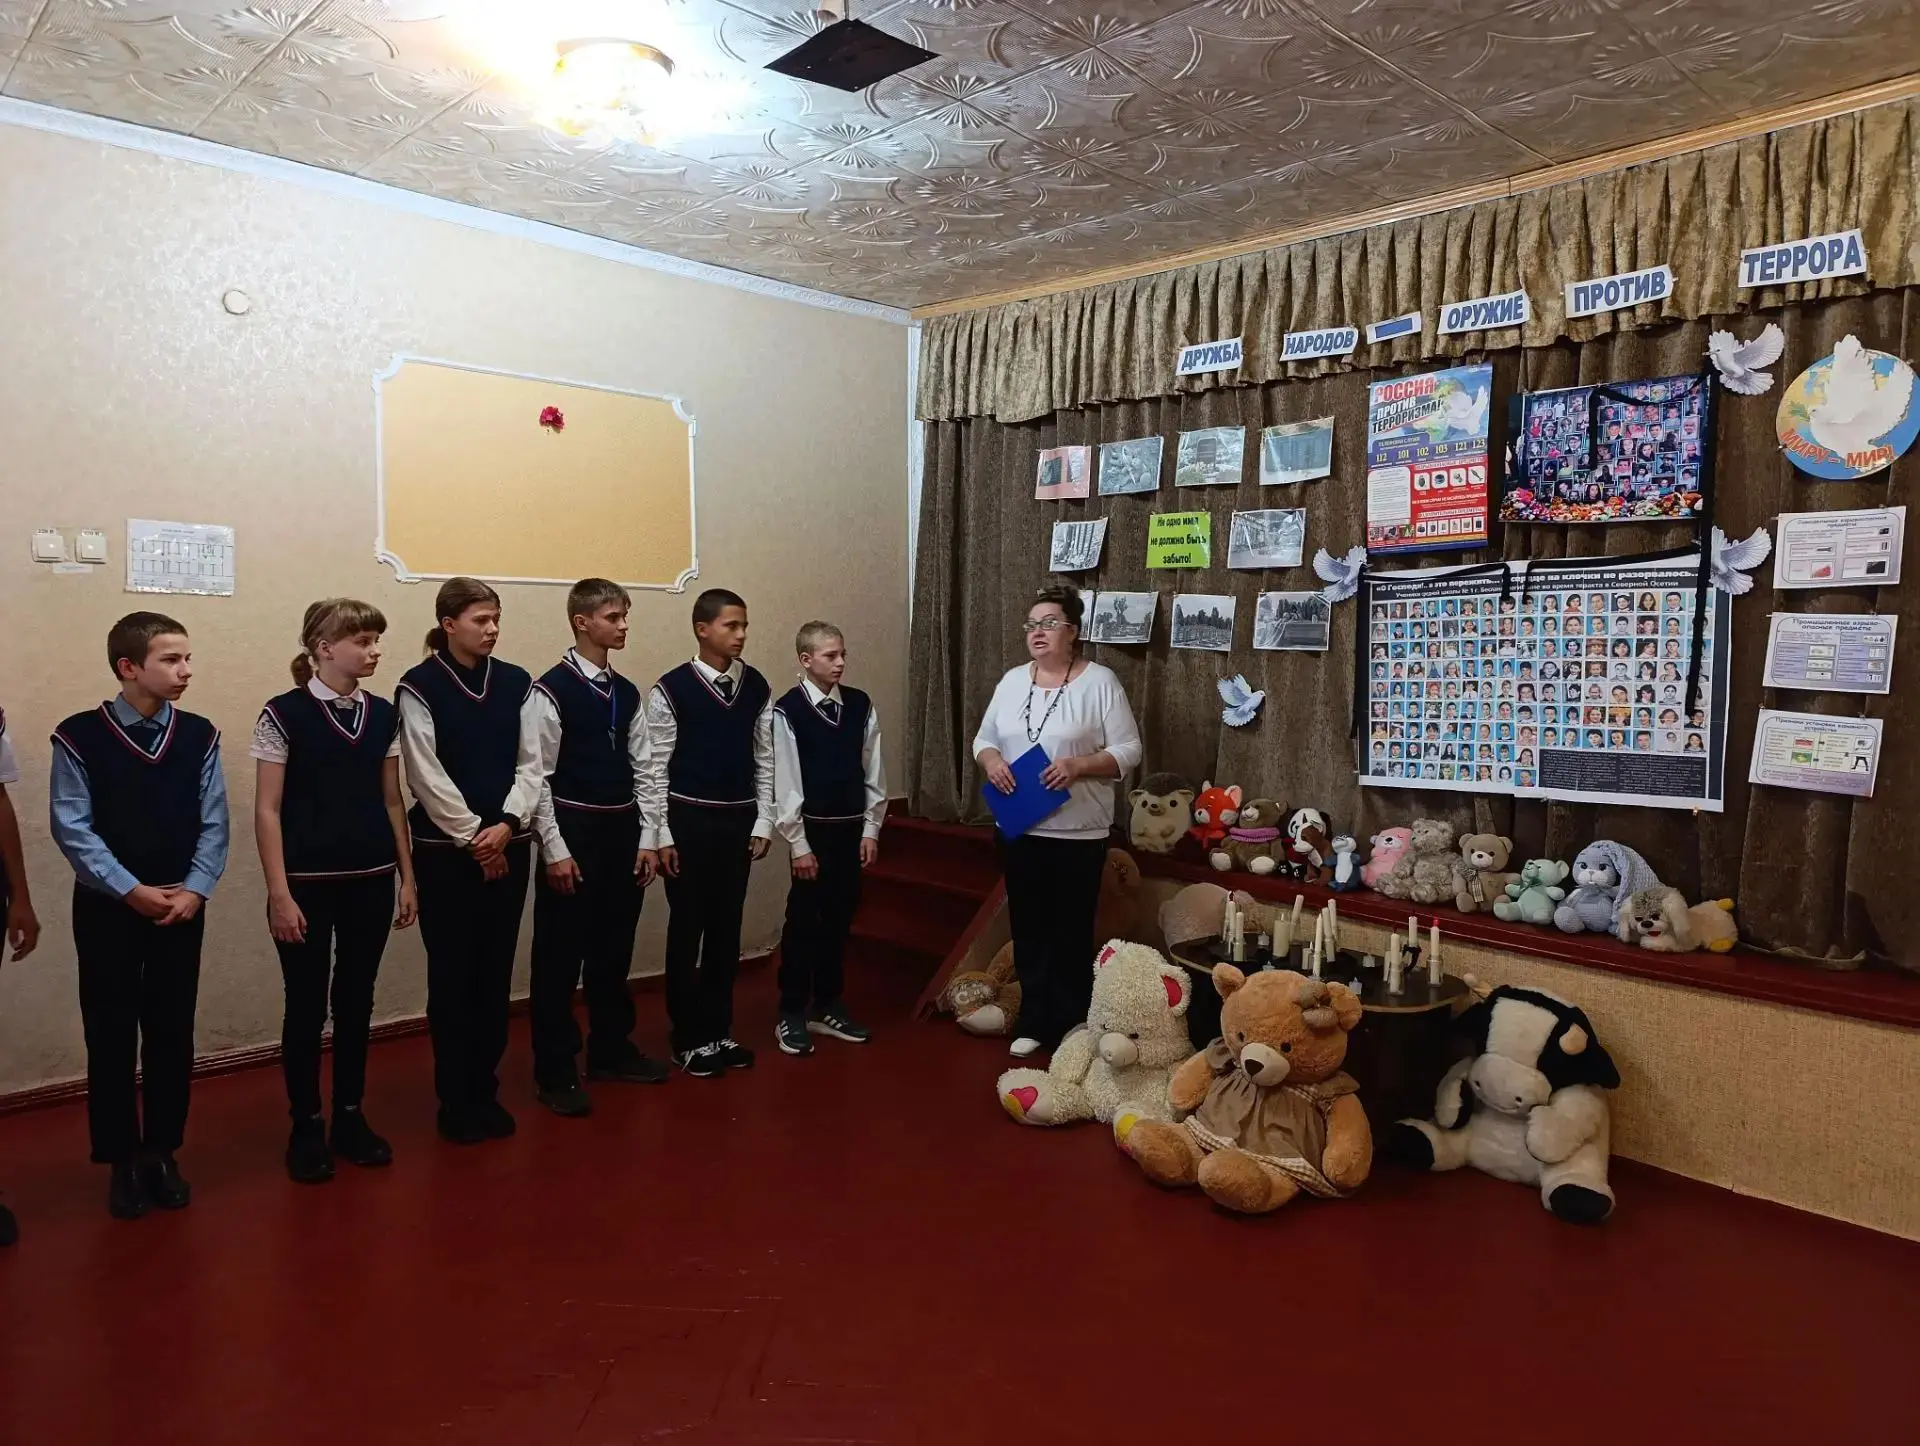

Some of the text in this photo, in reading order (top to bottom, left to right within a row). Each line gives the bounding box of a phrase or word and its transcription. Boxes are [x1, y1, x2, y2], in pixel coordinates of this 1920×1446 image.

[1181, 342, 1241, 371] ДРУЖБА
[1284, 330, 1356, 355] НАРОДОВ
[1447, 294, 1524, 330] ОРУЖИЕ
[1574, 270, 1666, 313] ПРОТИВ
[1743, 235, 1862, 283] ТЕРРОРА
[1375, 377, 1437, 403] РОССИЯ
[1376, 397, 1417, 420] ПРОТИВ
[1398, 449, 1410, 459] 101
[1416, 446, 1430, 457] 102
[1435, 443, 1448, 454] 103
[1780, 428, 1829, 464] МИРУ
[1151, 534, 1206, 547] не должно быть
[1163, 553, 1192, 564] забыто!
